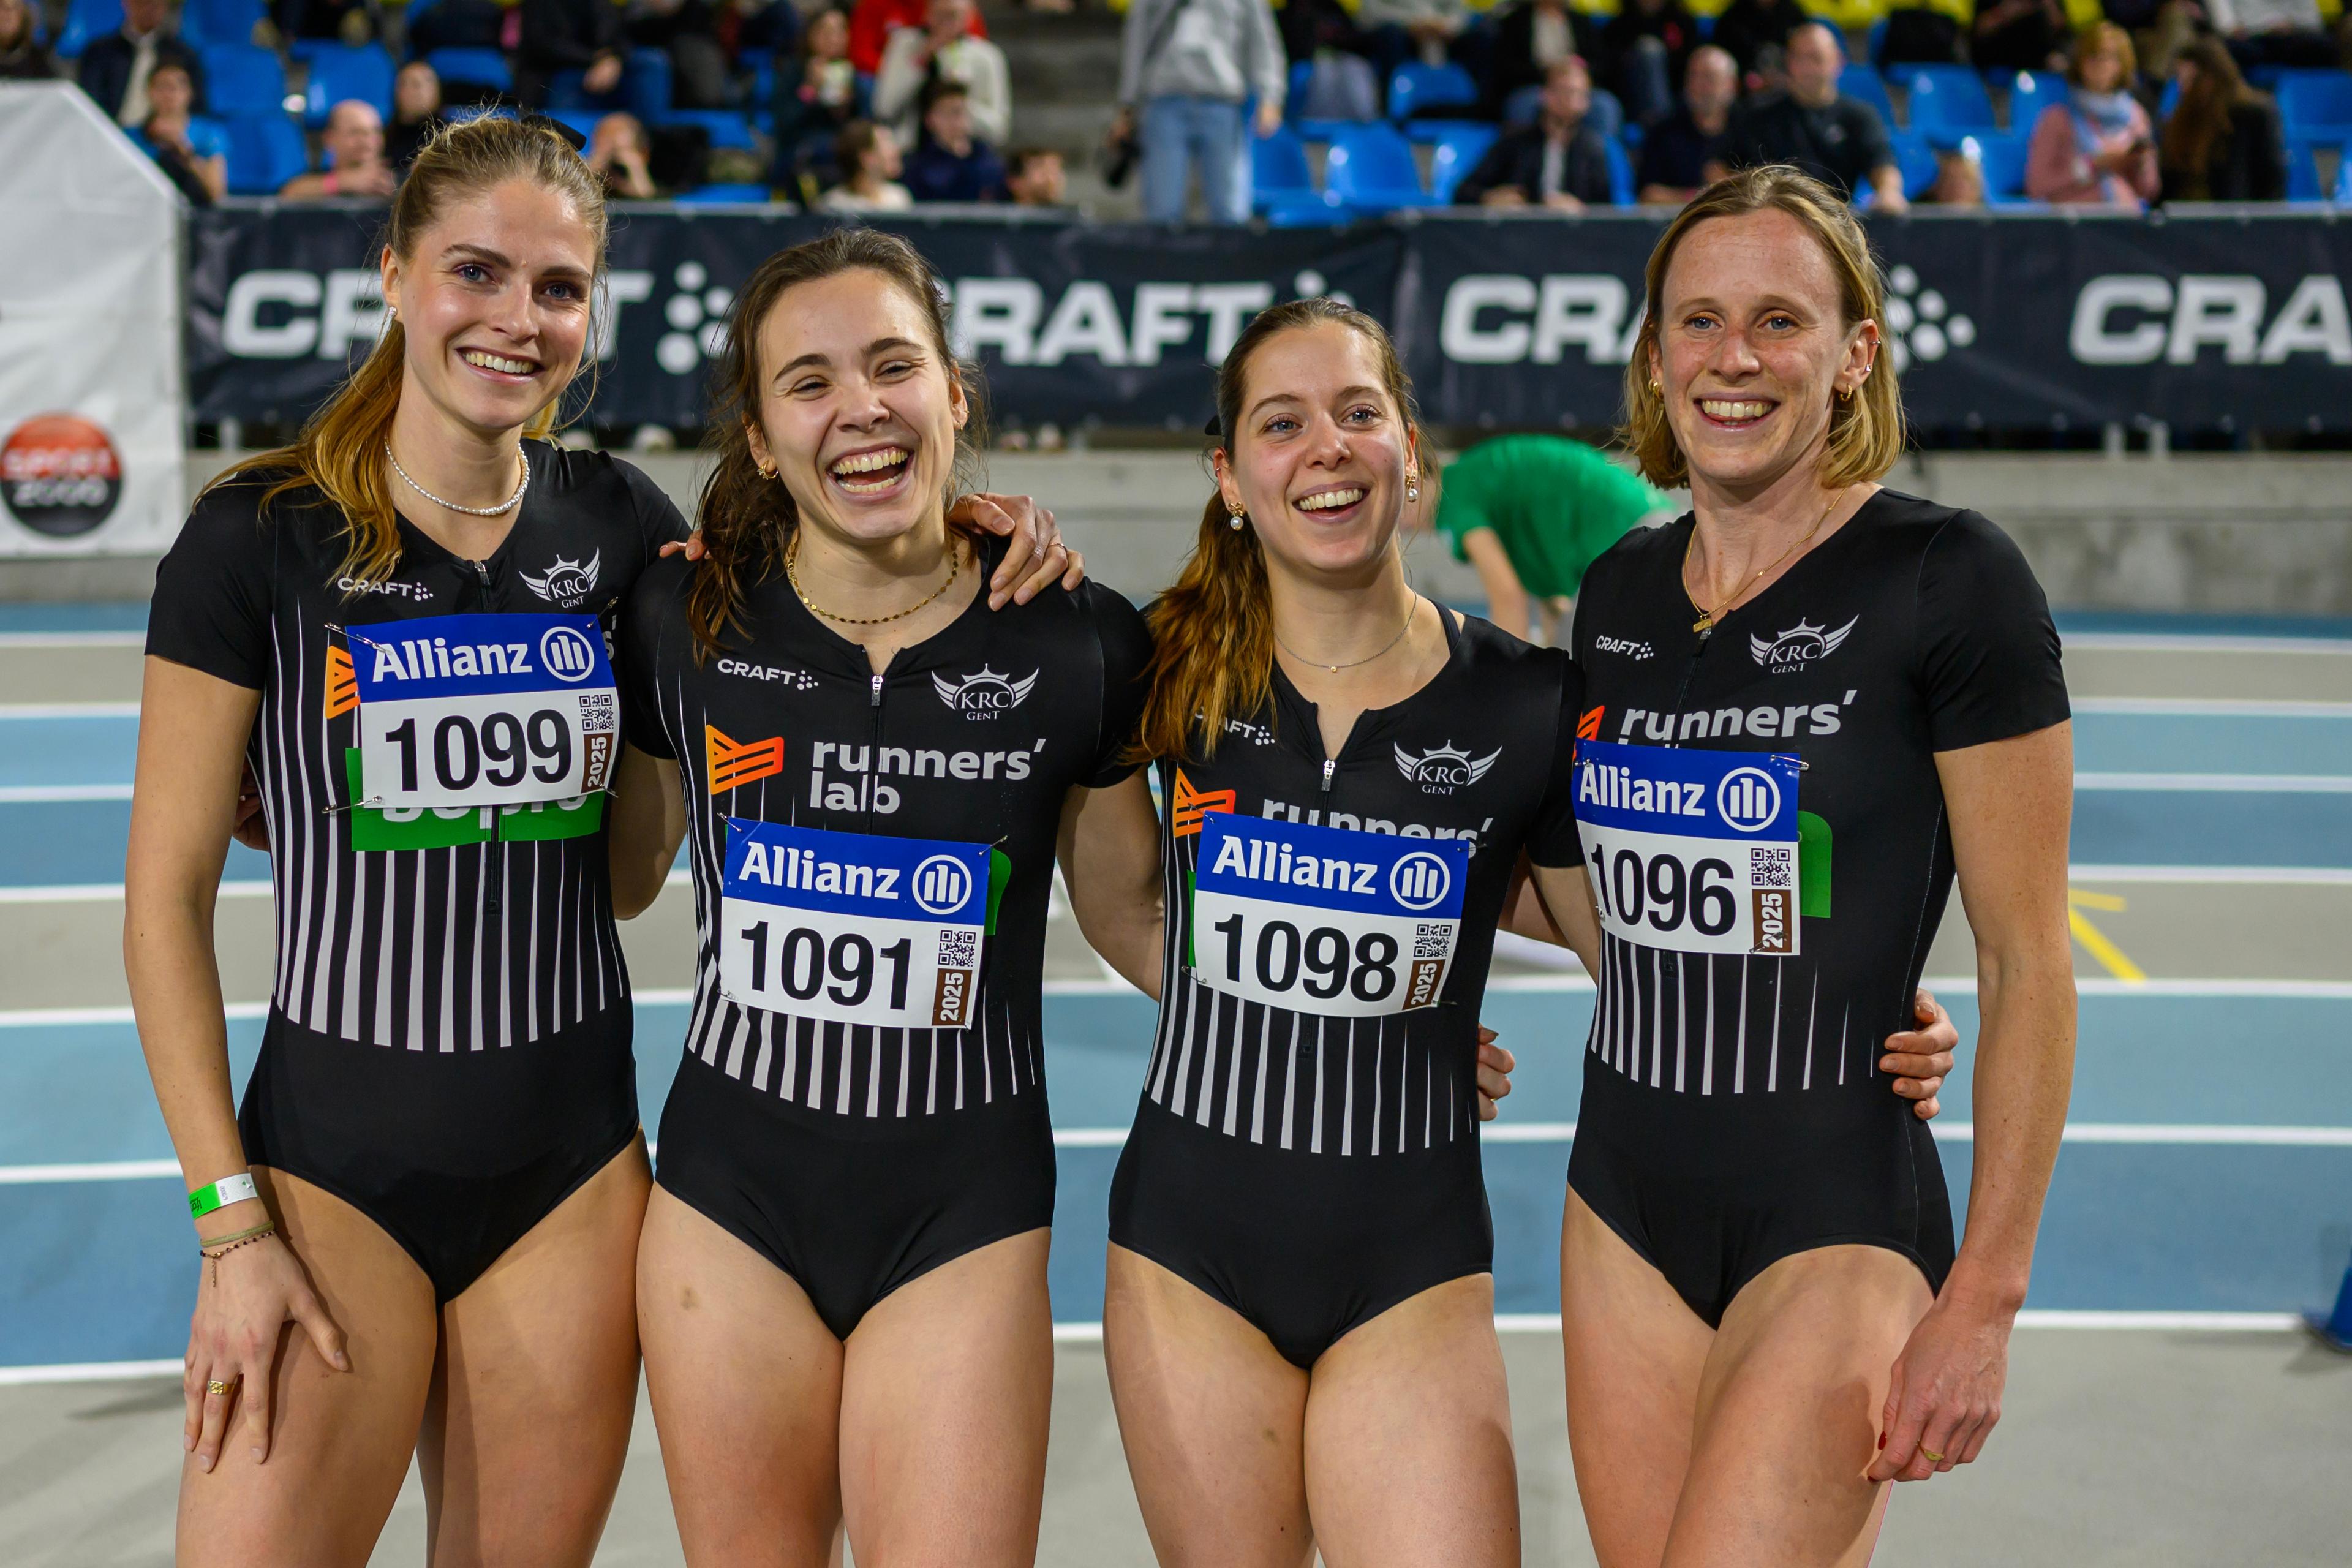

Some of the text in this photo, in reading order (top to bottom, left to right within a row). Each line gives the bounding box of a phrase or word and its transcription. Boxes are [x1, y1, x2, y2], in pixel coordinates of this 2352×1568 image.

[932, 277, 1276, 366] RAFT
[337, 577, 413, 597] CRAFT
[550, 575, 590, 600] KRC
[372, 637, 533, 683] Allianz
[1596, 635, 1640, 657] CRAFT
[1768, 641, 1822, 665] KRC
[717, 658, 796, 686] CRAFT
[960, 690, 1012, 710] KRC
[967, 710, 1000, 721] GENT
[1619, 690, 1858, 741] runners'
[385, 709, 572, 792] 1099
[587, 736, 606, 789] 2025
[812, 739, 1046, 780] runners'
[810, 770, 901, 815] lab
[1417, 763, 1468, 786] KRC
[1422, 783, 1455, 796] GENT
[1580, 763, 1705, 816] Allianz
[738, 841, 900, 900] Allianz
[1212, 835, 1378, 895] Allianz
[1591, 843, 1736, 937] 1096
[1761, 892, 1784, 949] 2025
[741, 920, 912, 1011] 1091
[1214, 913, 1399, 1003] 1098
[940, 971, 965, 1022] 2025
[1411, 962, 1438, 1006] 2025
